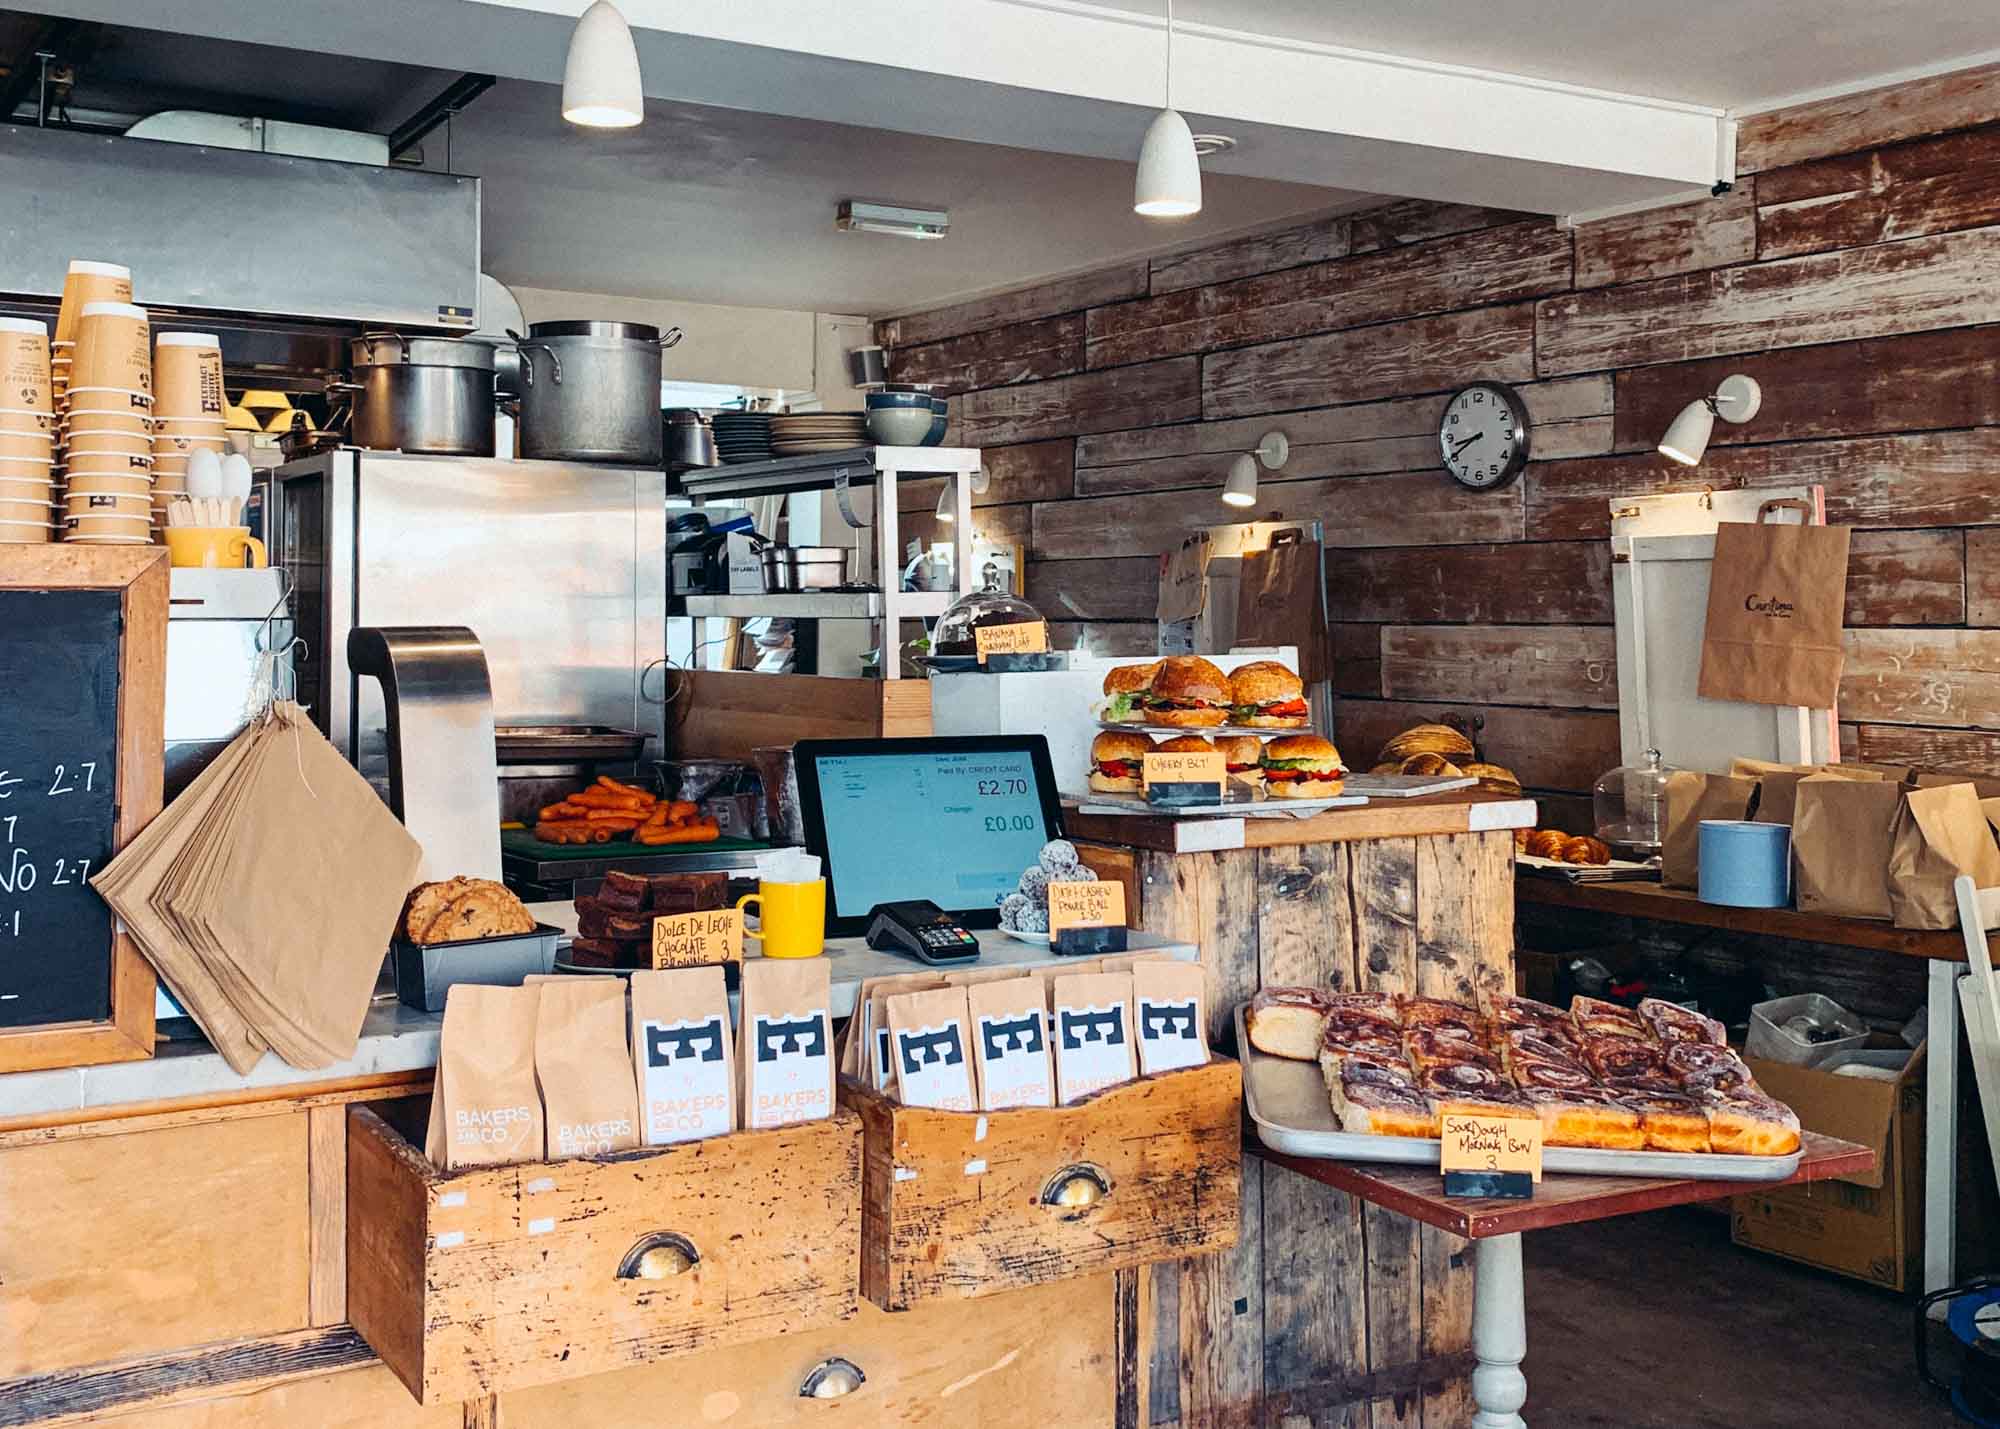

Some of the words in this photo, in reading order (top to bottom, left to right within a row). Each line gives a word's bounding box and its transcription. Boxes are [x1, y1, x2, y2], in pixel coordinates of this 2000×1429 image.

[200, 365, 209, 399] EXTRACT
[1461, 398, 1468, 409] 11
[1473, 392, 1483, 404] 12
[1450, 414, 1459, 425] 10
[1499, 410, 1508, 421] 2
[1446, 433, 1454, 444] 9
[1504, 429, 1513, 441] 3
[1500, 450, 1508, 460] 4
[1461, 465, 1469, 476] 7
[1475, 470, 1483, 481] 6
[1489, 464, 1498, 475] 5
[968, 765, 998, 774] CREDIT
[1000, 765, 1022, 773] CARD
[978, 779, 1027, 795] £2.70
[984, 815, 1035, 832] £0.00
[657, 921, 687, 941] DOLCE
[707, 913, 733, 936] LECHE
[656, 937, 707, 957] CHOCOLATE
[720, 939, 730, 961] 3
[757, 1088, 826, 1109] BAKERS
[653, 1094, 727, 1116] BAKERS
[456, 1106, 531, 1127] BAKERS
[560, 1119, 632, 1138] BAKERS
[1486, 1154, 1498, 1169] 3
